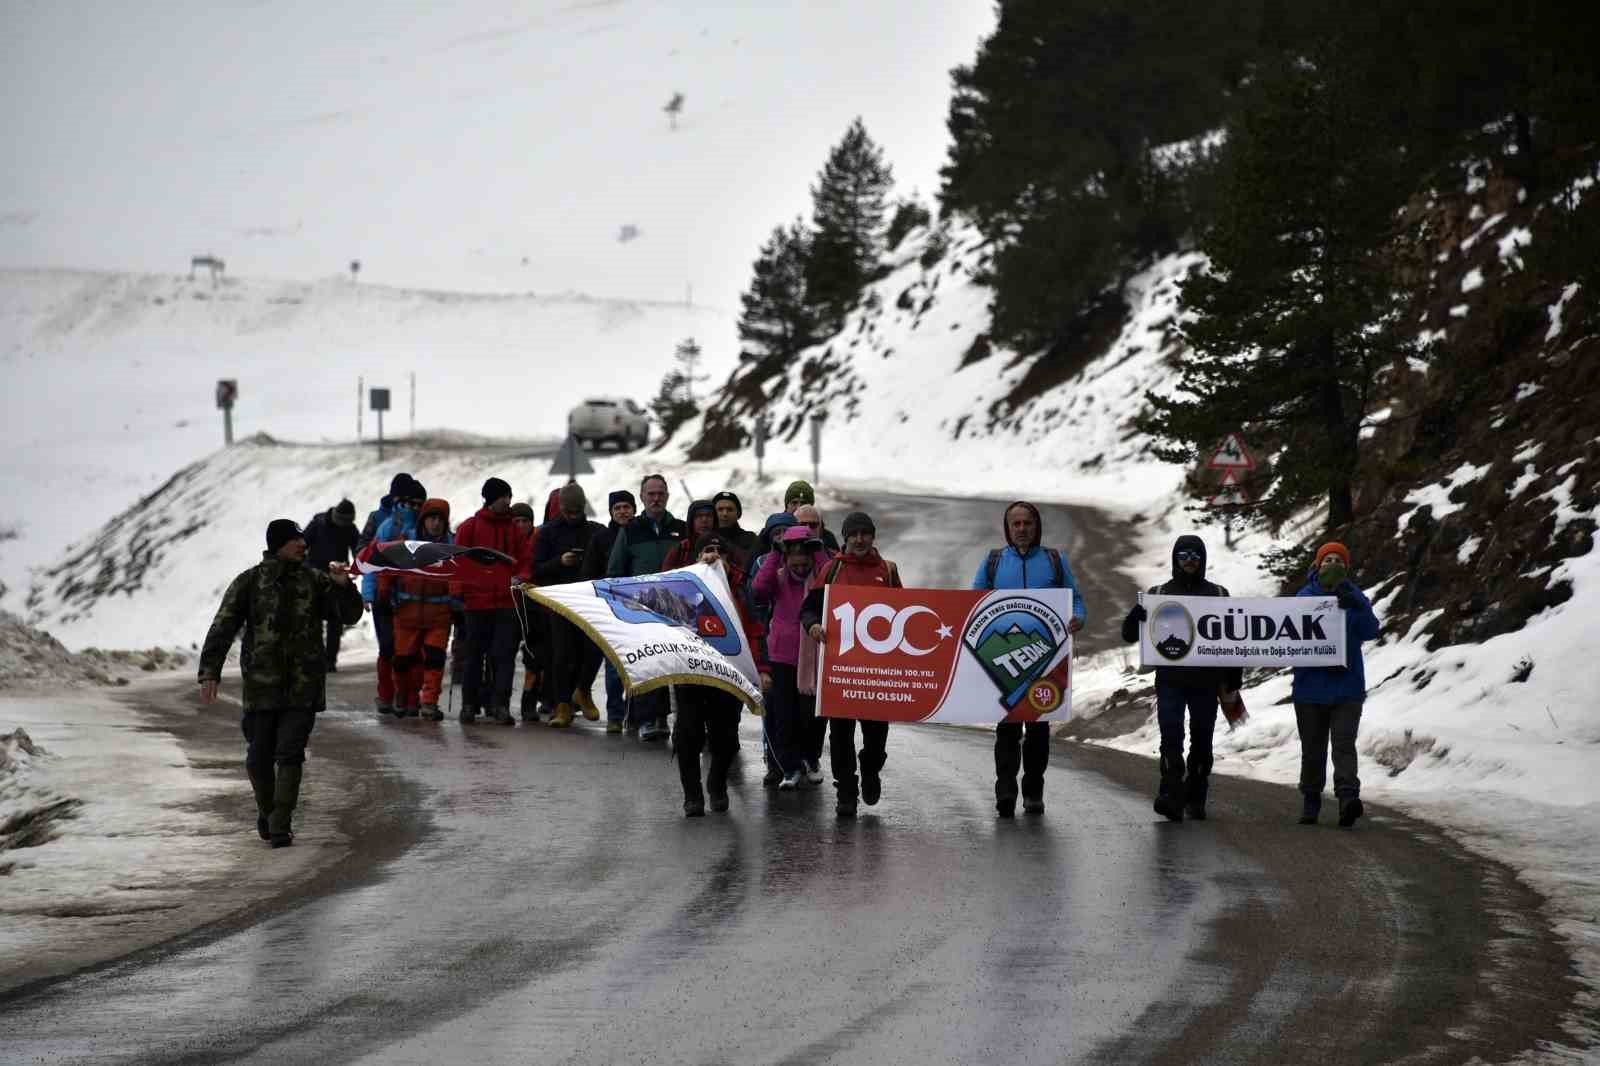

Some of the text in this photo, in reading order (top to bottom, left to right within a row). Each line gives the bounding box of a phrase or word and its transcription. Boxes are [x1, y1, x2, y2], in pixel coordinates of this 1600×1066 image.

[832, 601, 942, 656] 100
[1197, 608, 1327, 641] GÜDAK
[625, 642, 682, 665] DAĞCILIK
[992, 639, 1052, 678] TEDAK
[1197, 645, 1234, 658] Gümüşhane
[1235, 645, 1260, 658] Dağcılık
[1261, 648, 1269, 656] ve
[1270, 645, 1286, 658] Doğa
[1287, 645, 1313, 657] Sporları
[687, 657, 713, 672] SPOR
[842, 689, 915, 703] KUTLU OLSUN.
[1035, 687, 1050, 698] 30
